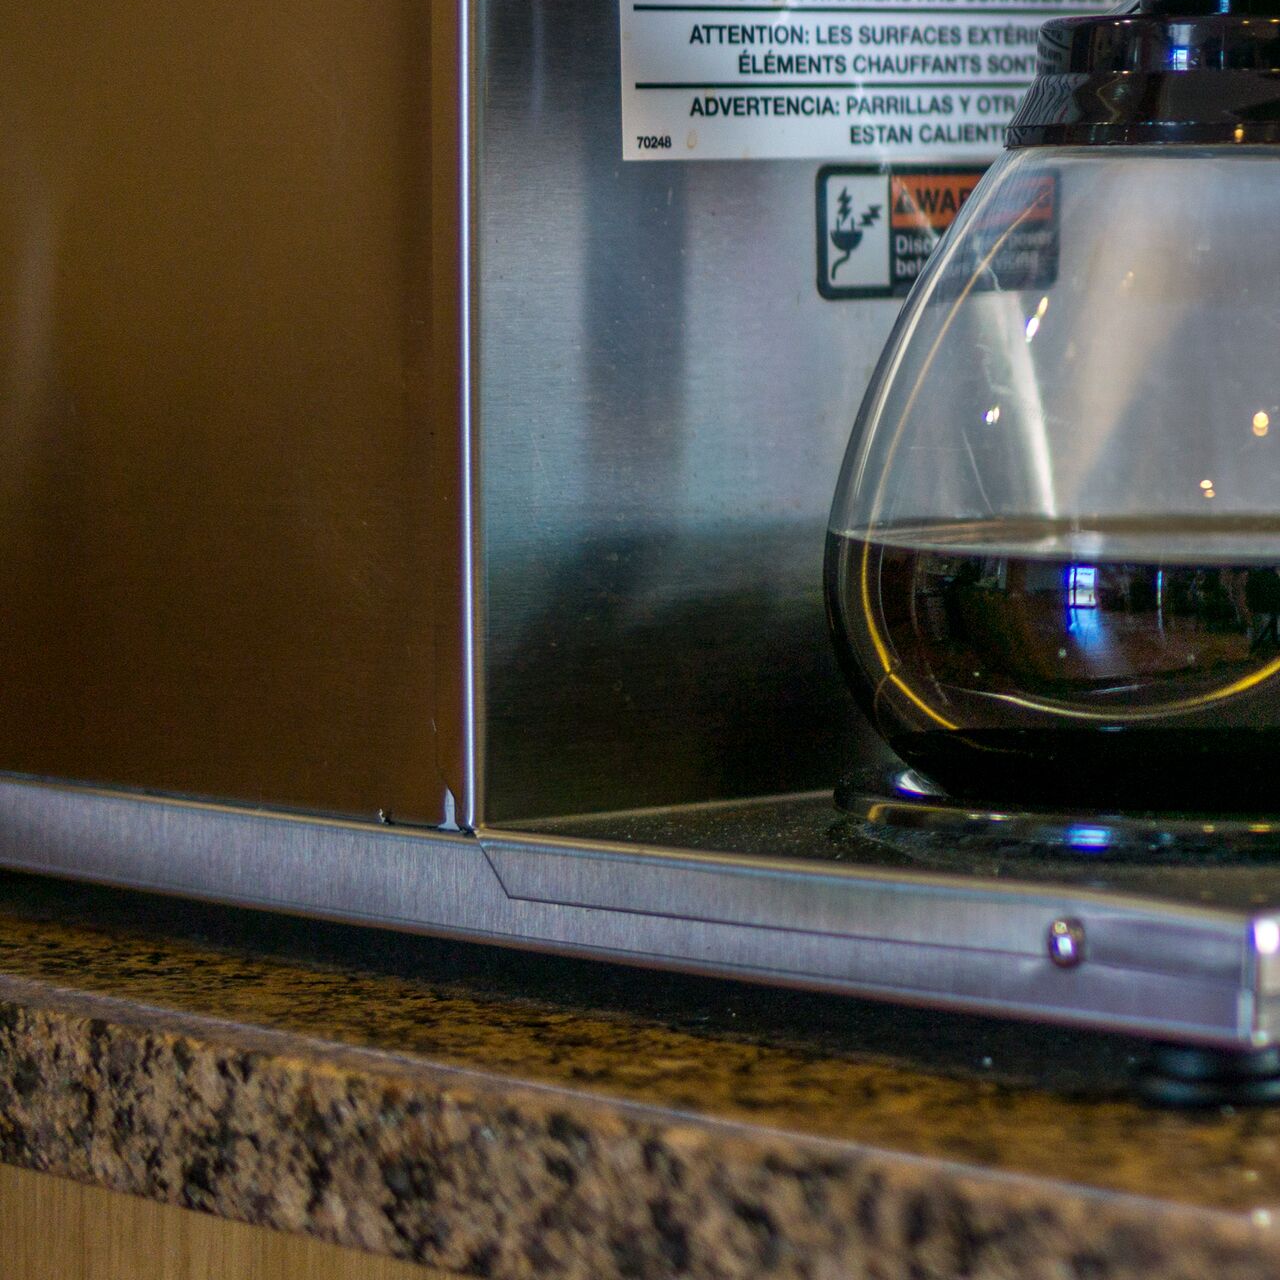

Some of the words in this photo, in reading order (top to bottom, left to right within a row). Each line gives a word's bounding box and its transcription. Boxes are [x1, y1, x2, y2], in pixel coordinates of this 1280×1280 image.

[689, 24, 809, 45] ATTENTION:
[816, 25, 853, 45] LES
[858, 26, 961, 45] SURFACES
[968, 22, 1040, 46] EXTÉRI
[739, 49, 847, 74] ÉLÉMENTS
[853, 54, 981, 74] CHAUFFANTS
[987, 54, 1038, 74] SONT
[690, 96, 840, 117] ADVERTENCIA:
[846, 95, 953, 116] PARRILLAS
[959, 95, 971, 114] Y
[637, 135, 672, 149] 70248
[850, 125, 912, 145] ESTAN
